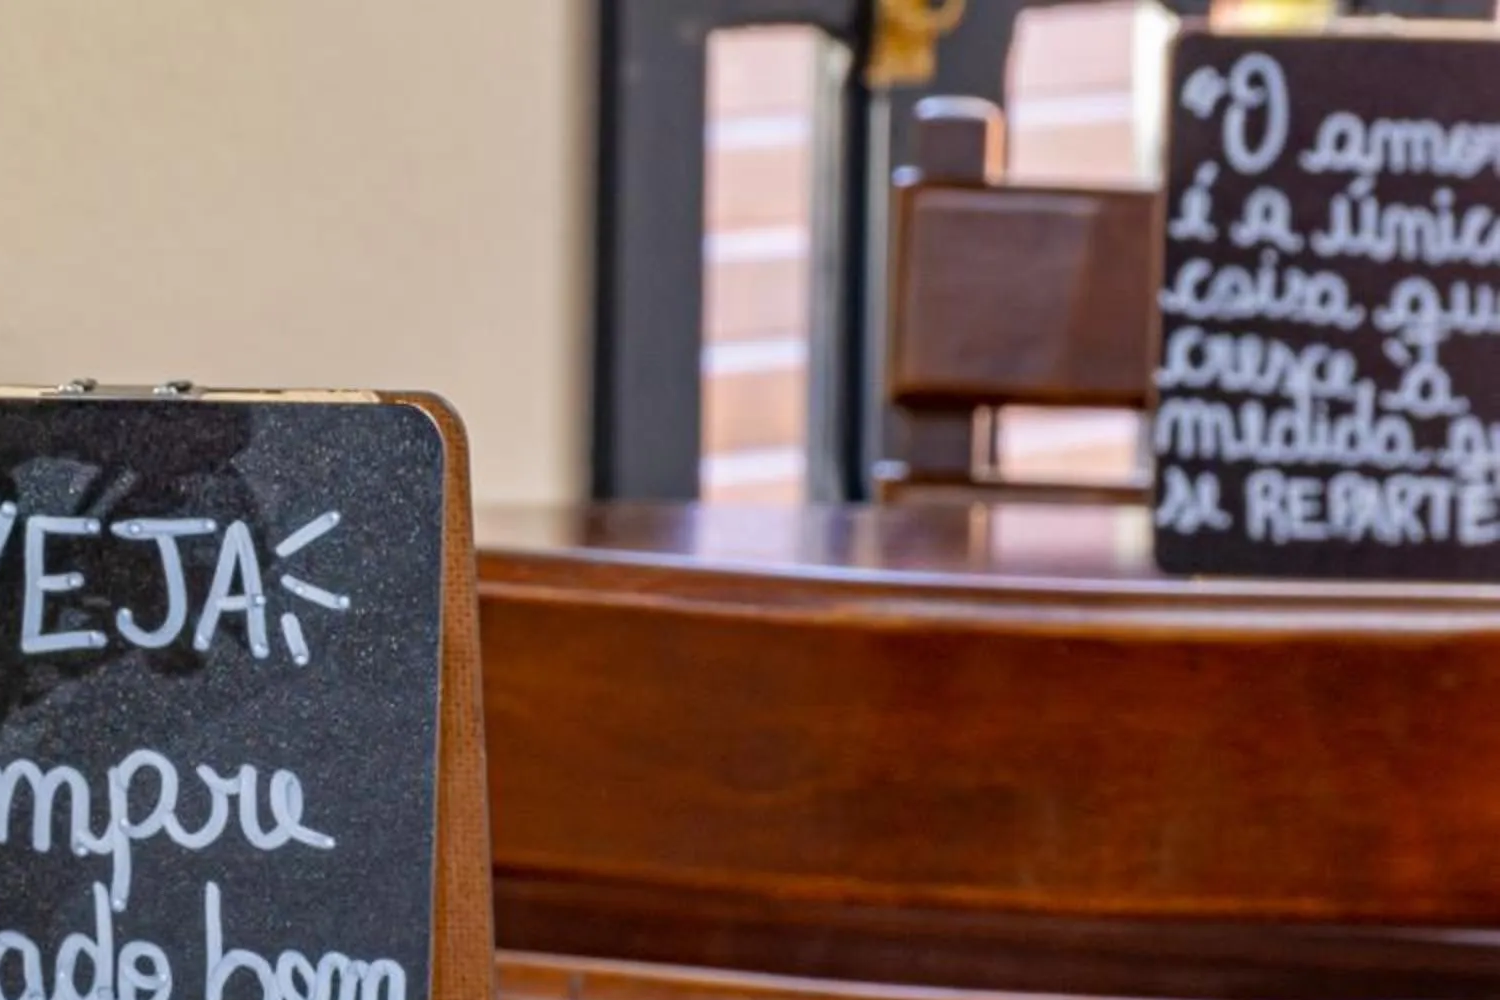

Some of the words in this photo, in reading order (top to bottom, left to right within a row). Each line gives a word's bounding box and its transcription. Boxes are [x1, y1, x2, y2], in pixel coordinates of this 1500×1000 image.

[1229, 186, 1305, 250] a
[1157, 248, 1366, 331] coisa
[1371, 275, 1500, 370] qu
[1244, 467, 1500, 546] REPARTE
